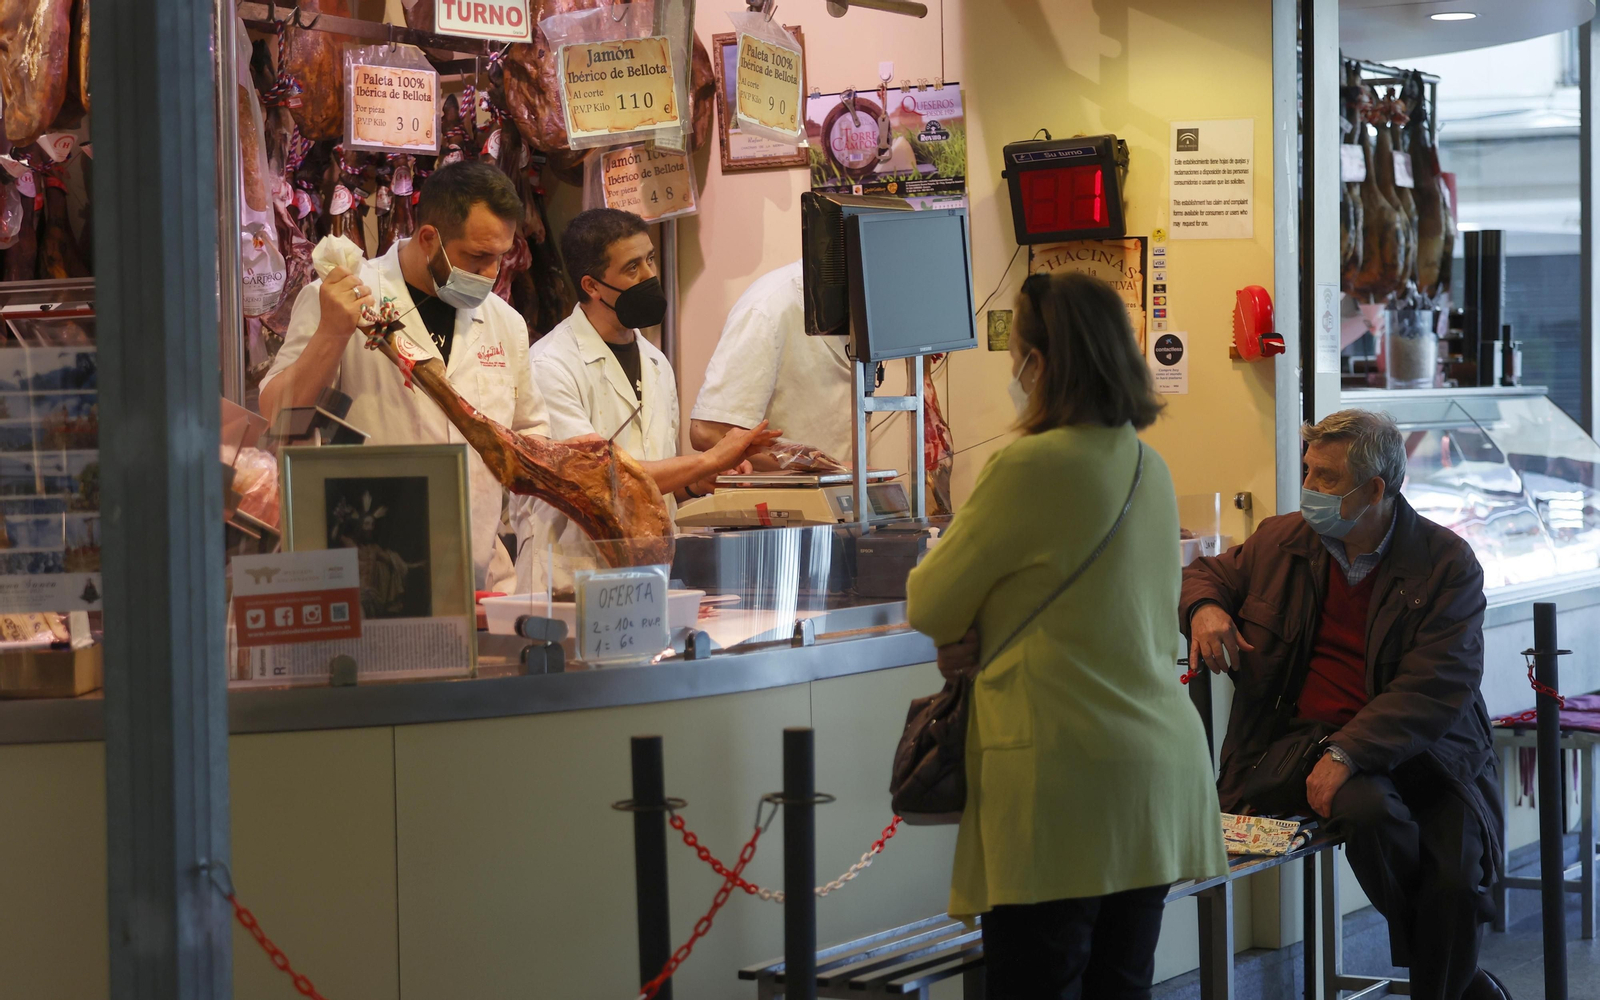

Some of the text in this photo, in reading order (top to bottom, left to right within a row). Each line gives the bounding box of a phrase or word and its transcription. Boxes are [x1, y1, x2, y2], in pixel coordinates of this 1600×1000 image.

[442, 0, 523, 27] TURNO
[586, 48, 635, 68] Jamón
[746, 44, 794, 70] Paleta 100%
[568, 64, 667, 84] Ibérico de Bellota
[741, 57, 798, 85] Ibérica de Bellota
[363, 74, 425, 89] Paleta 100%
[742, 77, 760, 90] Al corte
[356, 86, 432, 102] Ibérica de Bellota
[573, 88, 604, 98] Al corte
[752, 94, 762, 105] Kilo
[356, 105, 385, 114] Por pieza
[594, 102, 610, 111] Kilo
[617, 92, 654, 110] 110
[664, 104, 670, 114] €
[902, 96, 954, 116] QUESEROS
[841, 128, 876, 142] TORRE
[832, 137, 877, 152] CAMPOS
[606, 153, 641, 173] Jamón
[608, 163, 684, 185] Ibérico de Bellota
[620, 187, 637, 196] pieza
[627, 198, 641, 206] Kilo
[1036, 248, 1137, 279] CHACINAS
[1088, 268, 1097, 276] la
[599, 582, 653, 608] OFERTA
[593, 622, 602, 633] 2
[595, 640, 602, 658] 1
